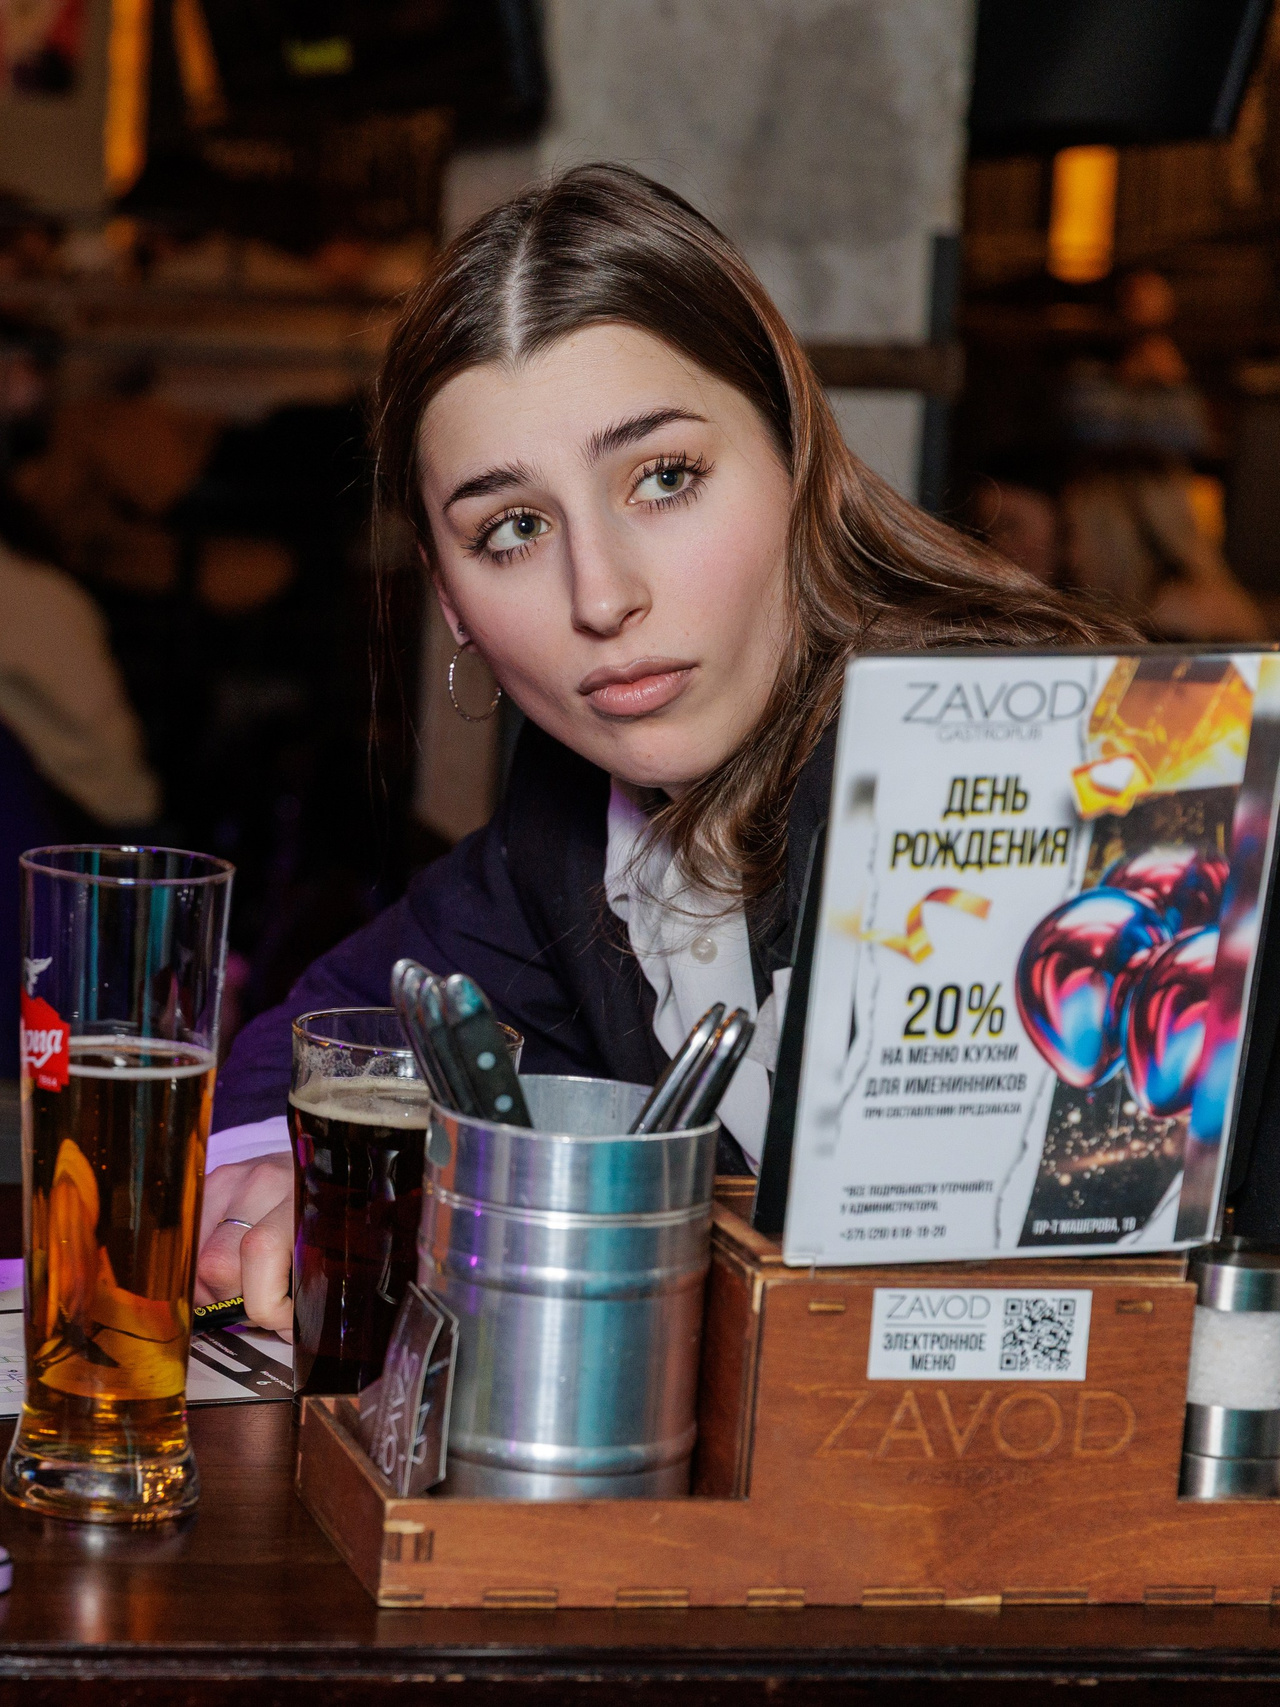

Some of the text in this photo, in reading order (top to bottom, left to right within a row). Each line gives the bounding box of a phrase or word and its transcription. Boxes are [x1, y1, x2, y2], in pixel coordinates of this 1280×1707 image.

[902, 680, 1088, 724] ZAVOD
[941, 775, 1029, 821] ДЕНЬ
[889, 827, 1071, 874] РОЖДЕНИЯ
[901, 982, 1006, 1041] 20%
[881, 1043, 1020, 1066] НА МЕНЮ КУХНИ
[864, 1073, 1028, 1099] ДЛЯ ИМЕНИННИКОВ
[886, 1294, 992, 1320] ZAVOD
[883, 1333, 988, 1352] ЭЛЕКТРОННОЕ
[910, 1353, 957, 1372] МЕНЮ
[816, 1389, 1137, 1459] ZAVOD
